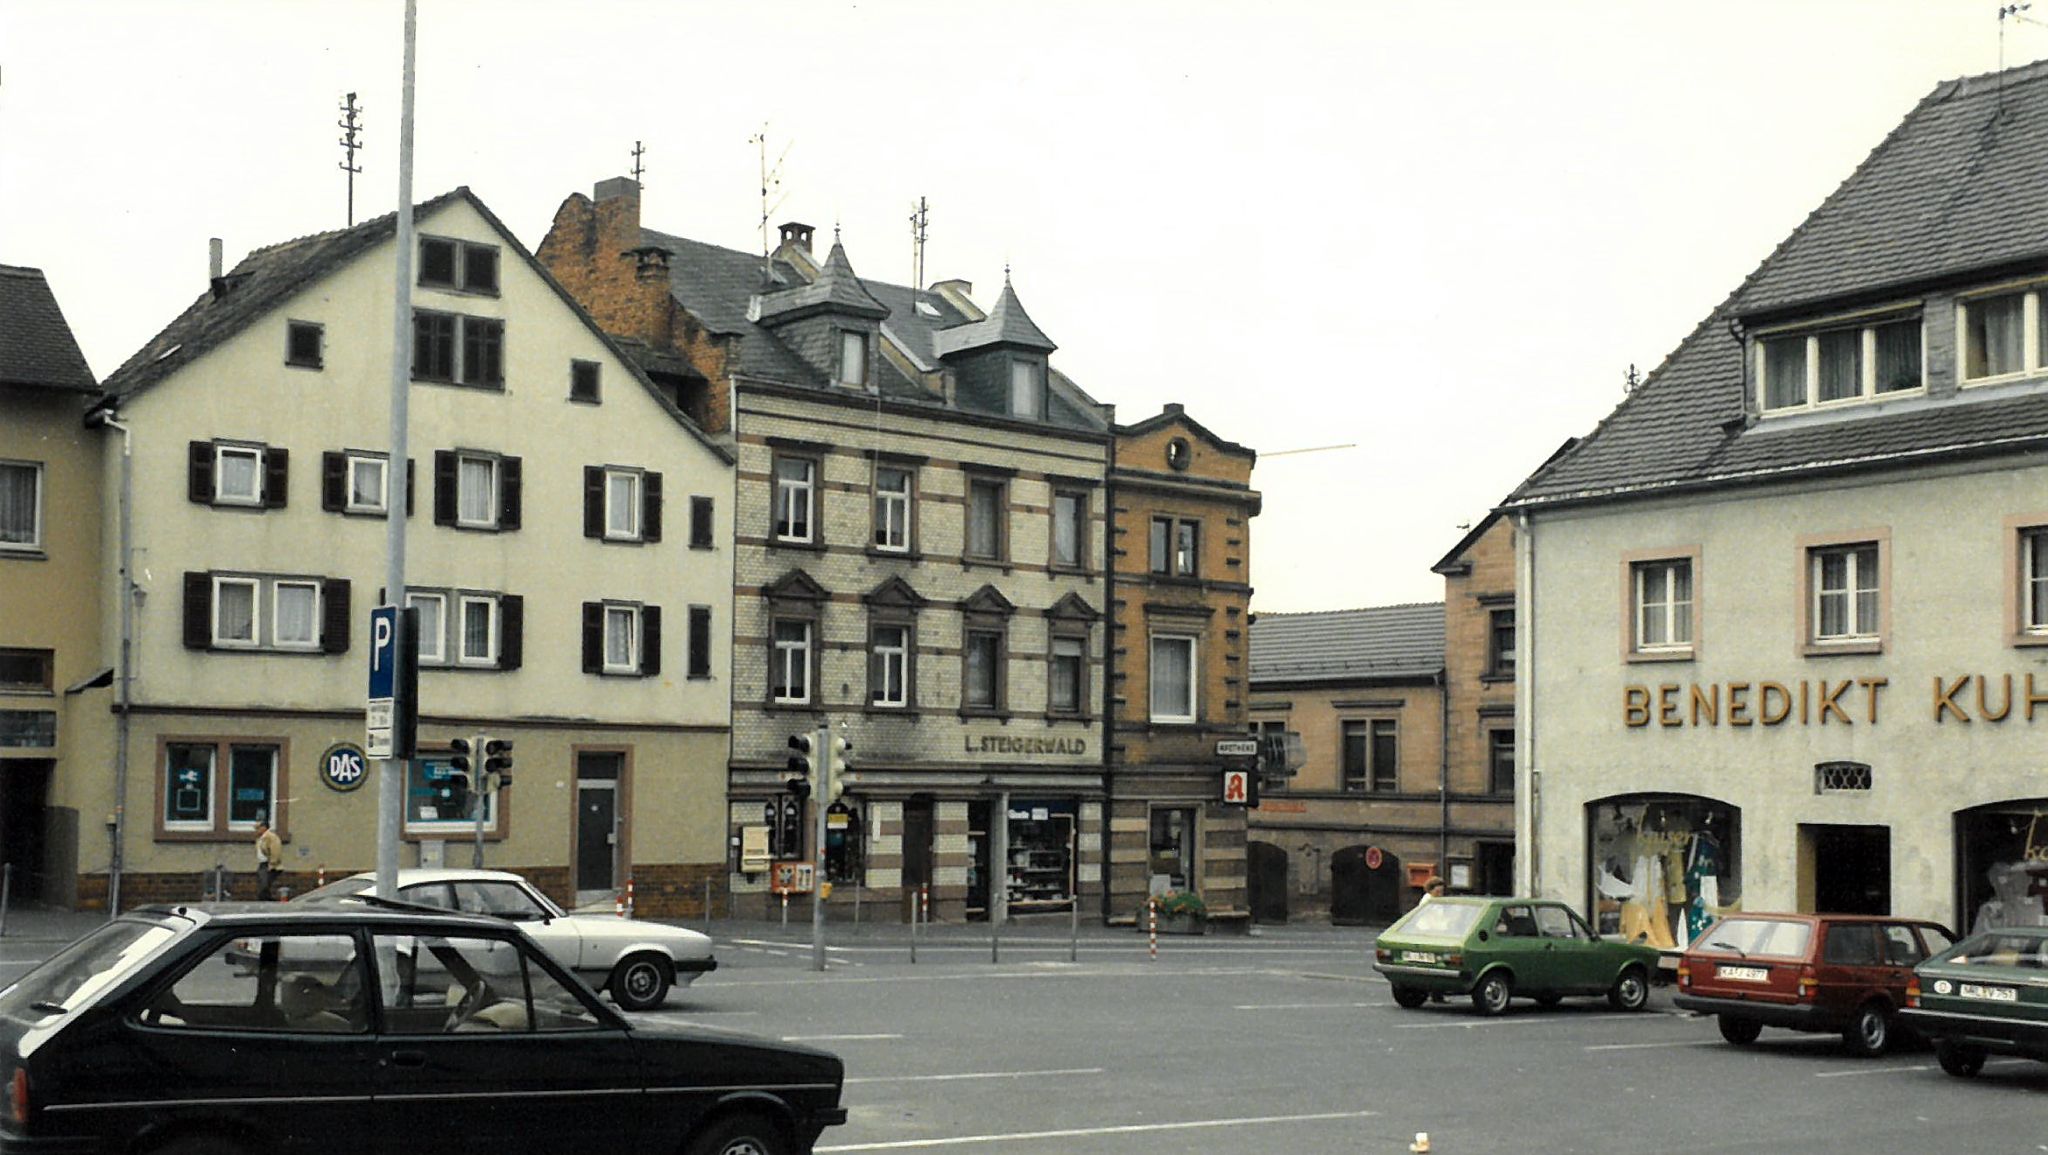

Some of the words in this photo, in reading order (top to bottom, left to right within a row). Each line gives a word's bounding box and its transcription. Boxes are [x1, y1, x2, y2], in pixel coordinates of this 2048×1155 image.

[374, 617, 391, 671] P
[1623, 677, 1889, 727] BENEDIKT
[330, 754, 361, 781] DAS
